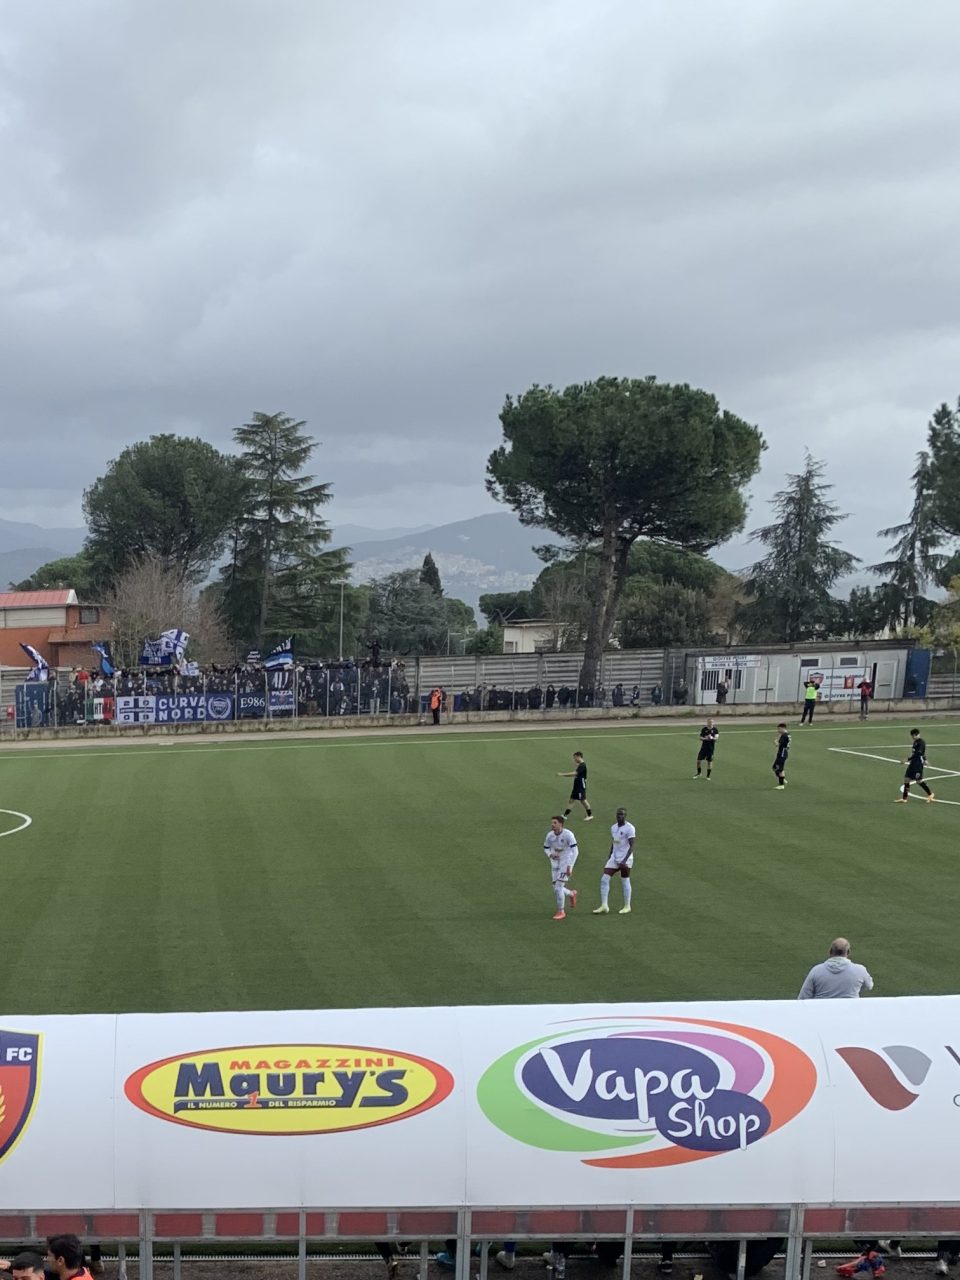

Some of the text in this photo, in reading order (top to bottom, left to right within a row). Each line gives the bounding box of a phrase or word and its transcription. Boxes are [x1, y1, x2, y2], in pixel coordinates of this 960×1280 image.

[158, 696, 206, 709] CURVA
[159, 708, 206, 721] NORD
[6, 1047, 33, 1061] FC
[229, 1058, 394, 1070] MAGAZZINI
[174, 1060, 409, 1108] Maury's
[540, 1047, 716, 1123] Vapa
[198, 1101, 237, 1109] NUMERO
[243, 1091, 262, 1109] 1
[268, 1100, 285, 1108] DEL
[288, 1099, 336, 1107] RISPARMIO
[667, 1100, 761, 1150] Shop
